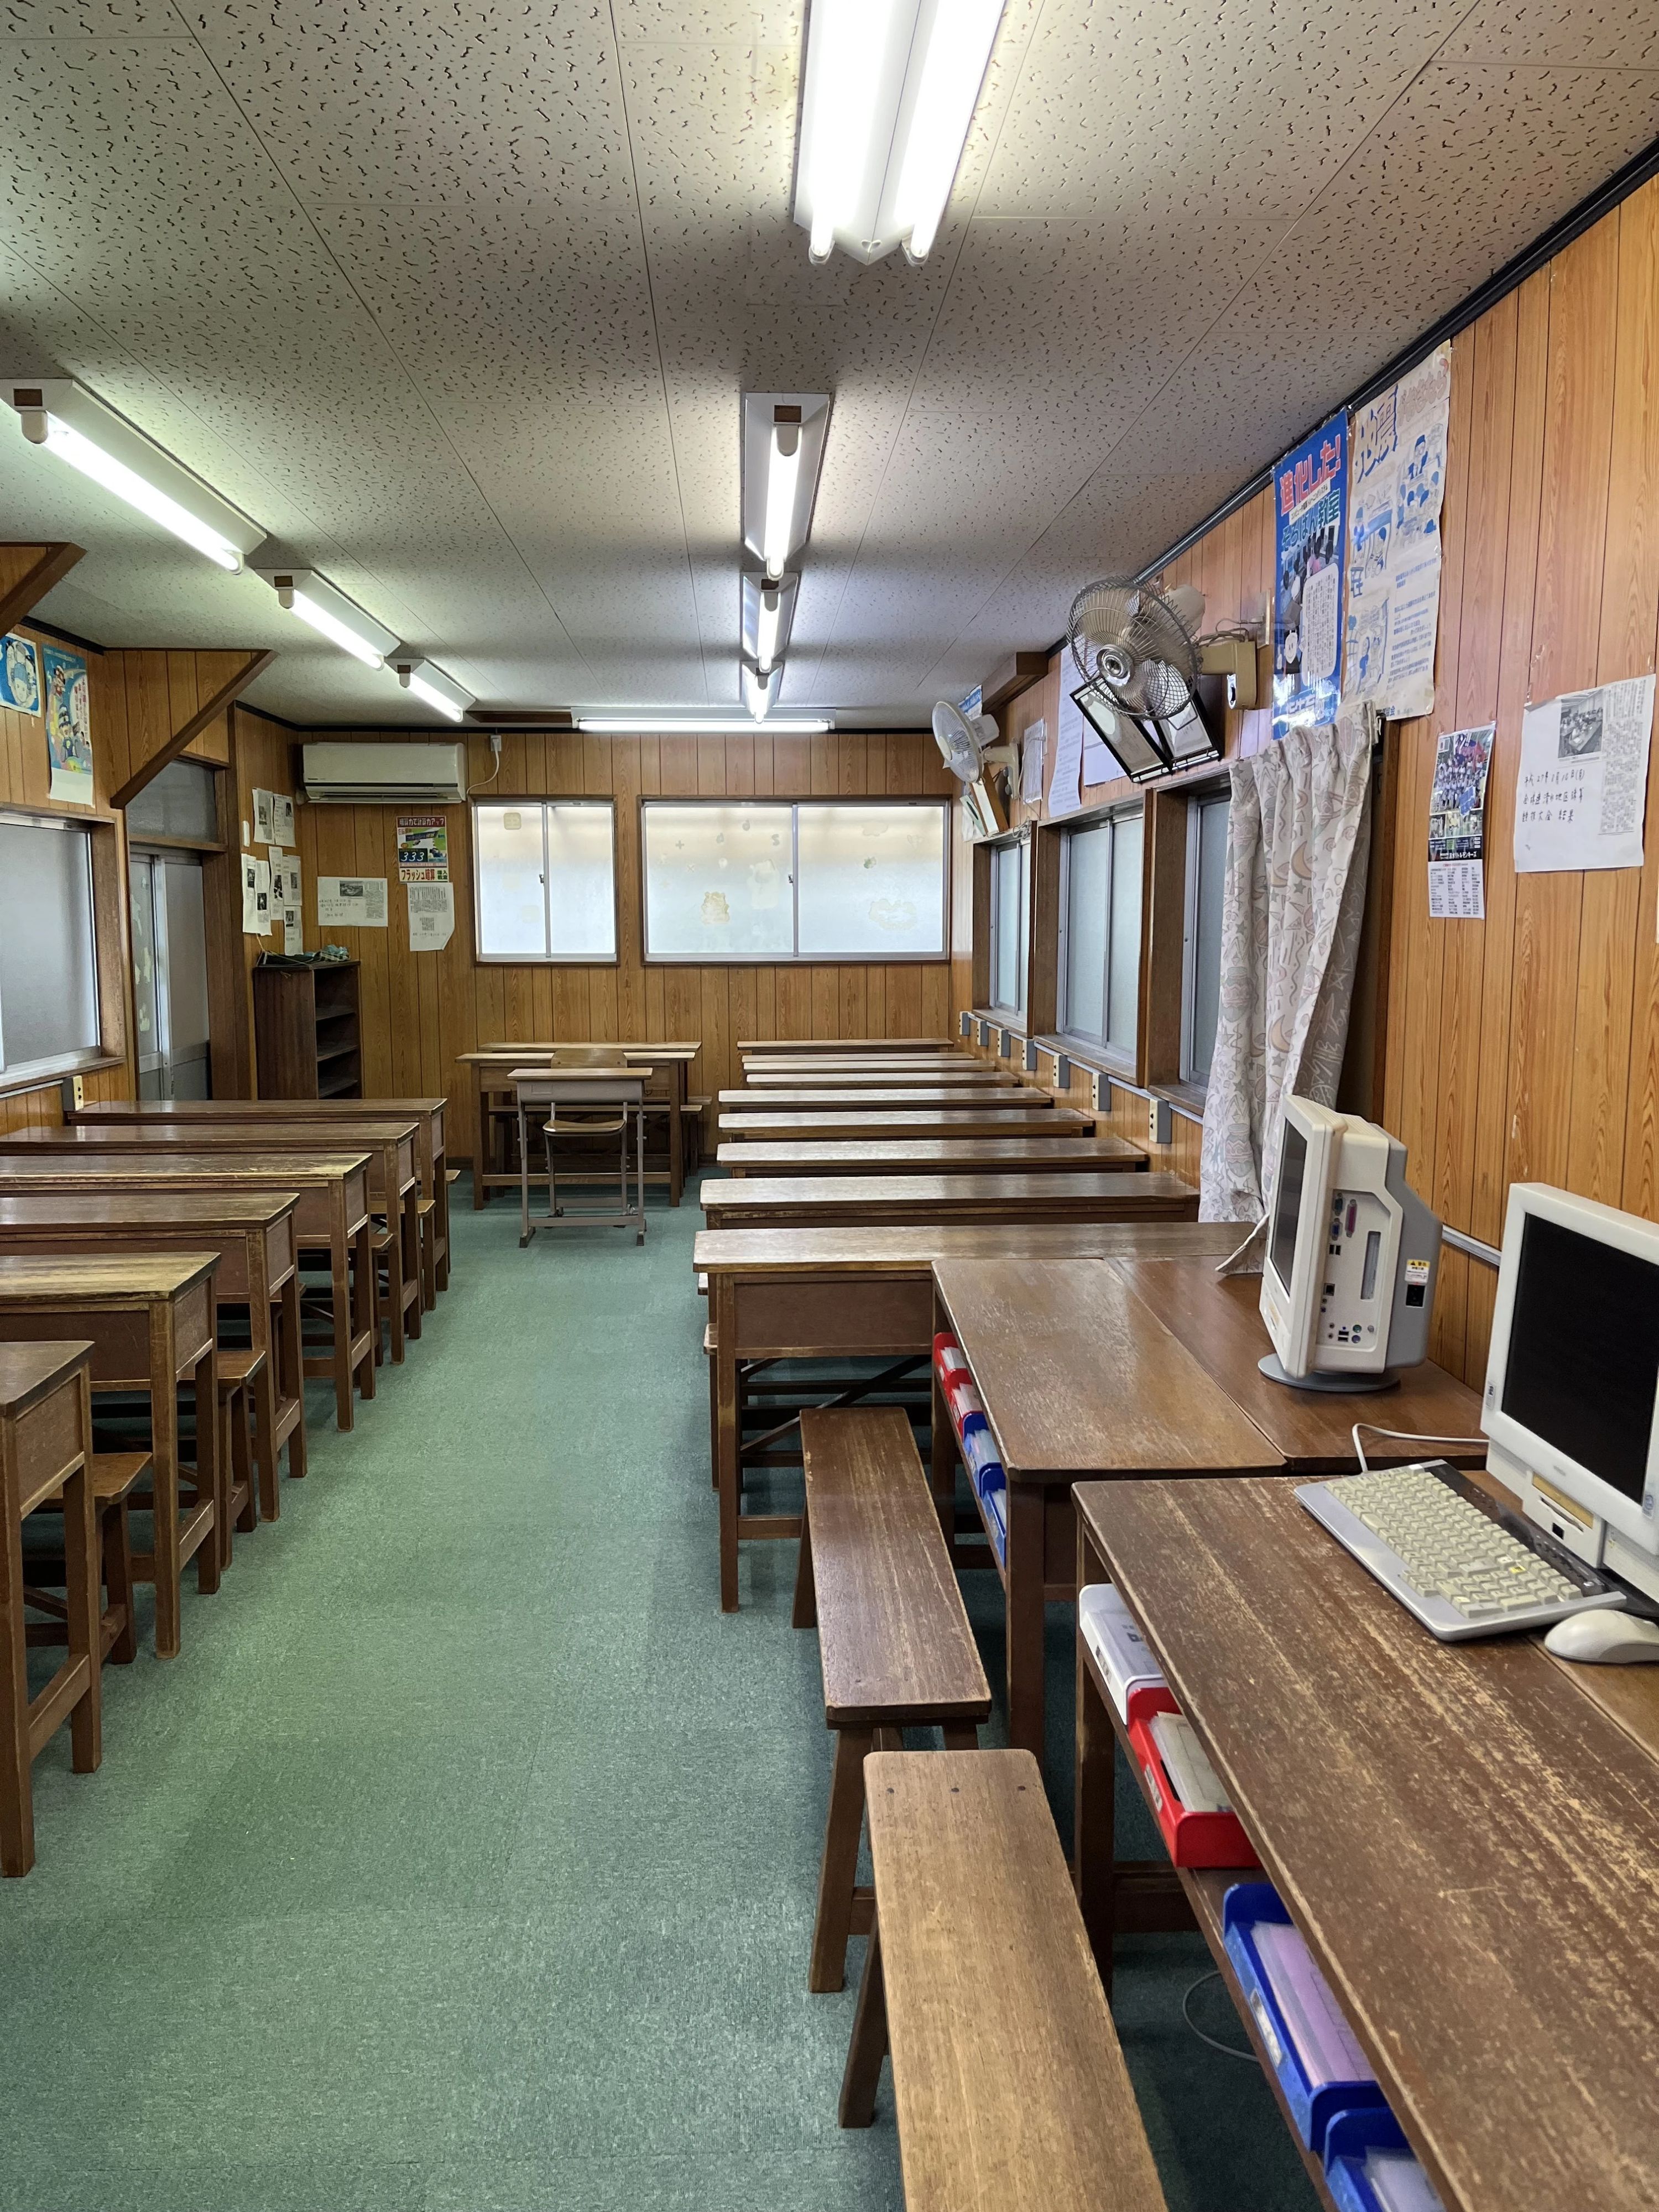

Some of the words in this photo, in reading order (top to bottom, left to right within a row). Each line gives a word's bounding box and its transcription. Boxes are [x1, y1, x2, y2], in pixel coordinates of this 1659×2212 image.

[1280, 434, 1341, 517] 進化した!
[1282, 488, 1341, 552] そろばん教室
[401, 869, 435, 881] フラッシュ暗算
